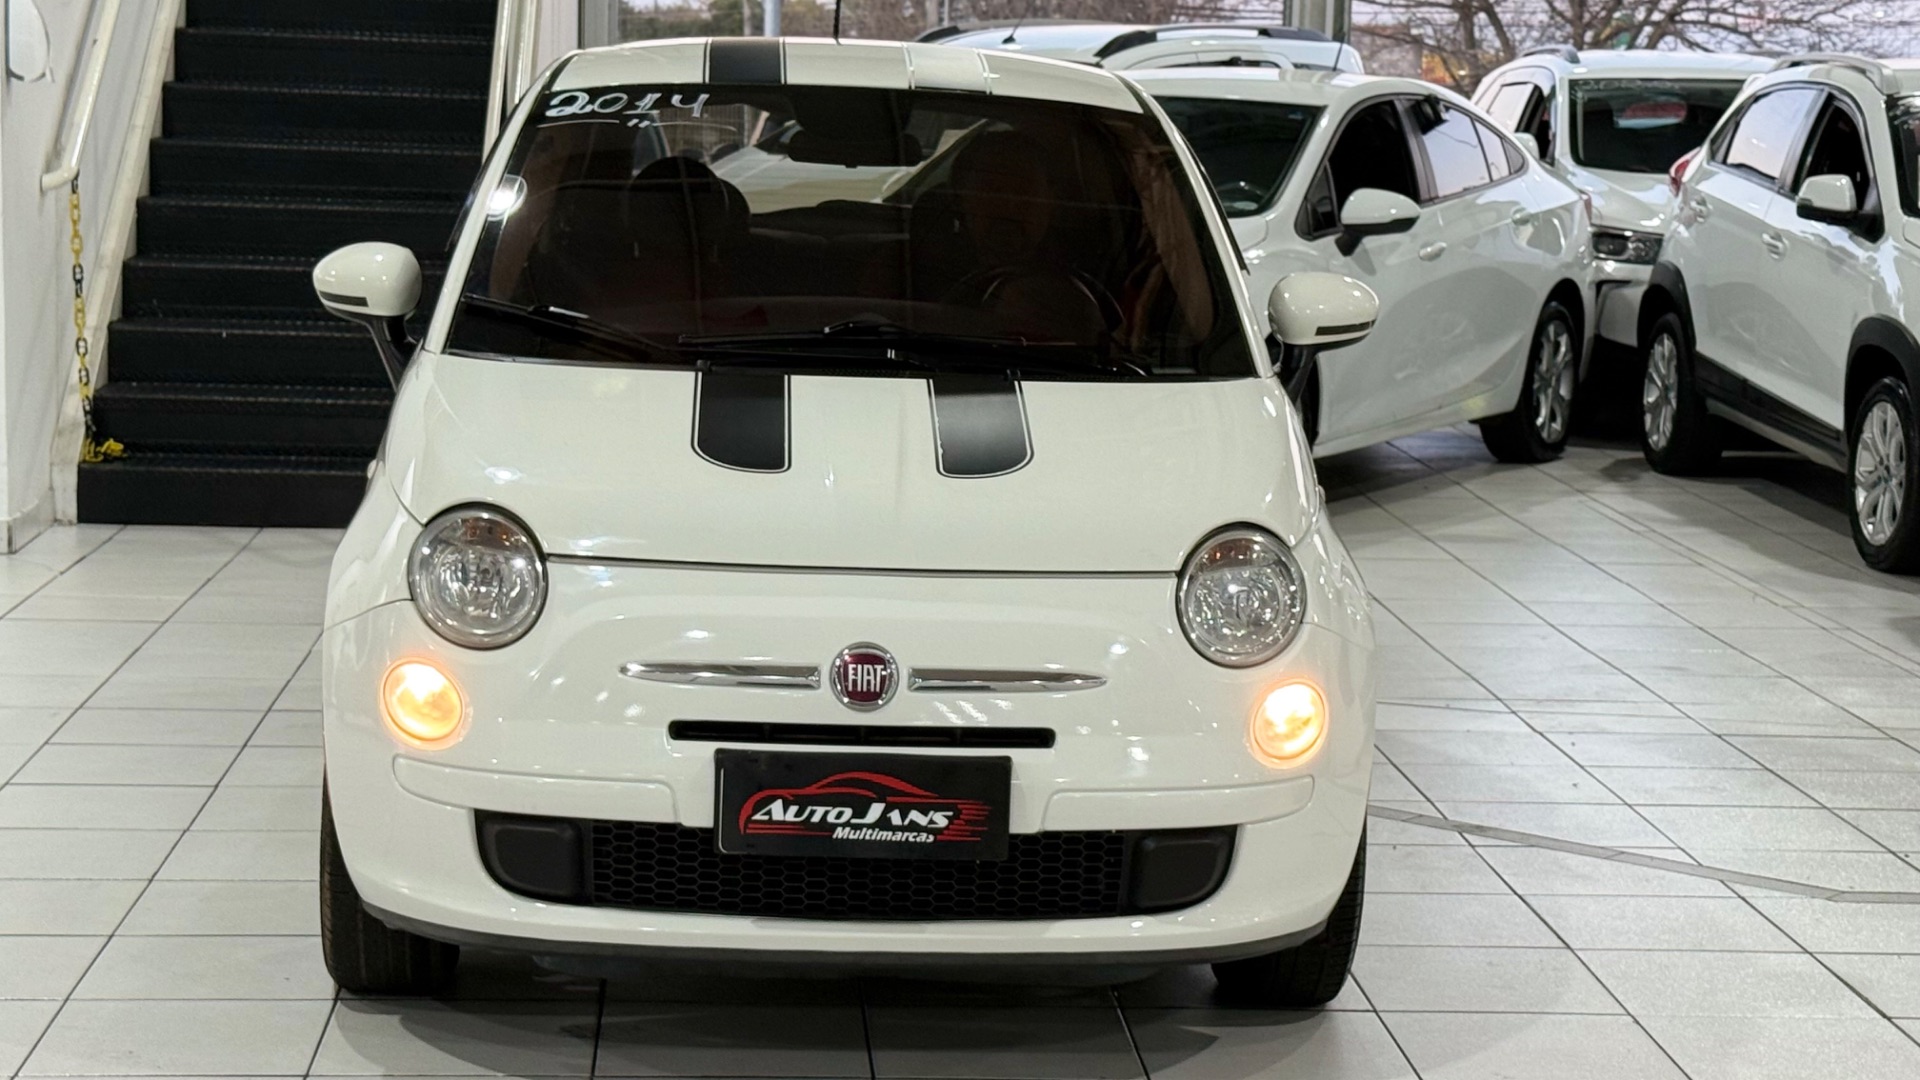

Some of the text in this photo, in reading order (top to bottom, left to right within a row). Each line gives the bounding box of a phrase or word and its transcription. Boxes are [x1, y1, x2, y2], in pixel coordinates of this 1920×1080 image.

[545, 91, 709, 117] 2014
[848, 664, 884, 692] FIAT
[832, 827, 934, 843] Multimarcas
